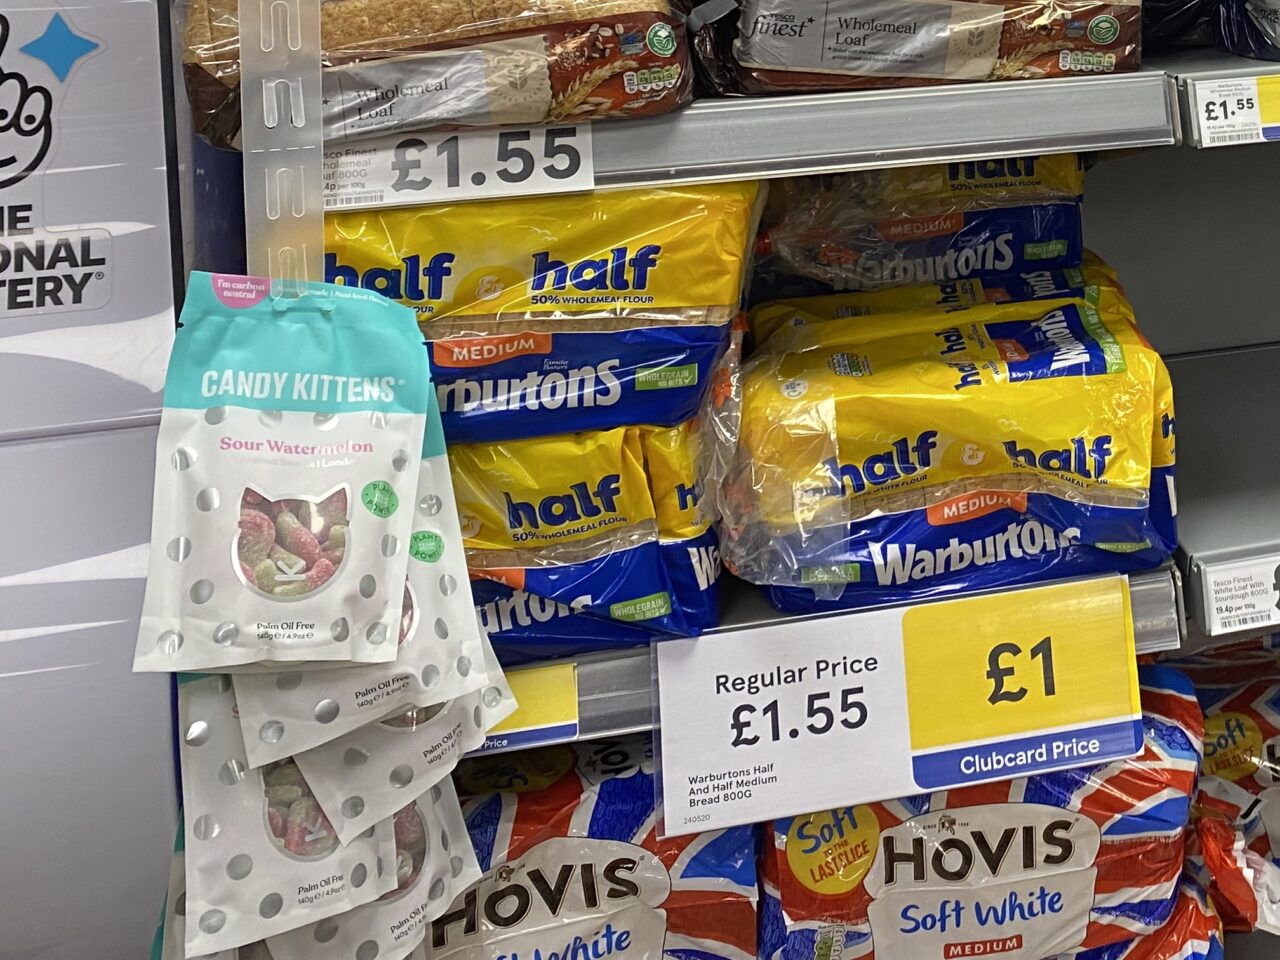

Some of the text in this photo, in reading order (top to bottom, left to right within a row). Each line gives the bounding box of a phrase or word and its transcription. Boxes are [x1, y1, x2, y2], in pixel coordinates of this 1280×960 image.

[838, 16, 917, 35] Wholemeal
[835, 32, 869, 46] Loaf
[356, 77, 448, 103] Wholemeal
[358, 102, 396, 121] Loaf
[1205, 98, 1254, 122] £1.55
[391, 127, 581, 193] £1.55
[891, 220, 951, 234] MEDIUM
[325, 253, 455, 301] half
[530, 245, 661, 291] half
[217, 279, 265, 291] I'm carbon
[223, 289, 256, 299] neutral
[531, 294, 653, 304] 50% WHOLEMEAL FLOUR
[453, 338, 534, 361] MEDIUM
[201, 369, 395, 403] CANDY KITTENS
[219, 436, 374, 456] Sour Watermelon
[821, 431, 938, 497] half
[1003, 435, 1112, 479] half
[504, 474, 621, 530] half
[943, 495, 1013, 518] MEDIUM
[1213, 581, 1264, 595] White Loaf With
[1233, 575, 1252, 584] Finest
[1215, 589, 1268, 603] Sourdough 800G
[615, 598, 664, 616] WHOLEGRAIN
[257, 621, 315, 632] Palm Oil Free
[716, 656, 878, 694] Regular Price
[985, 636, 1056, 706] £1
[354, 674, 410, 700] Palm Oil Free
[731, 686, 868, 748] £1.55
[485, 739, 507, 748] Price
[961, 736, 1099, 774] Clubcard Price
[688, 763, 774, 784] Warburtons Half
[689, 775, 777, 796] And Half Medium
[689, 790, 752, 807] Bread 800G
[884, 819, 1074, 885] HOVIS
[900, 887, 1064, 934] Soft White
[948, 939, 1019, 957] MEDIUM
